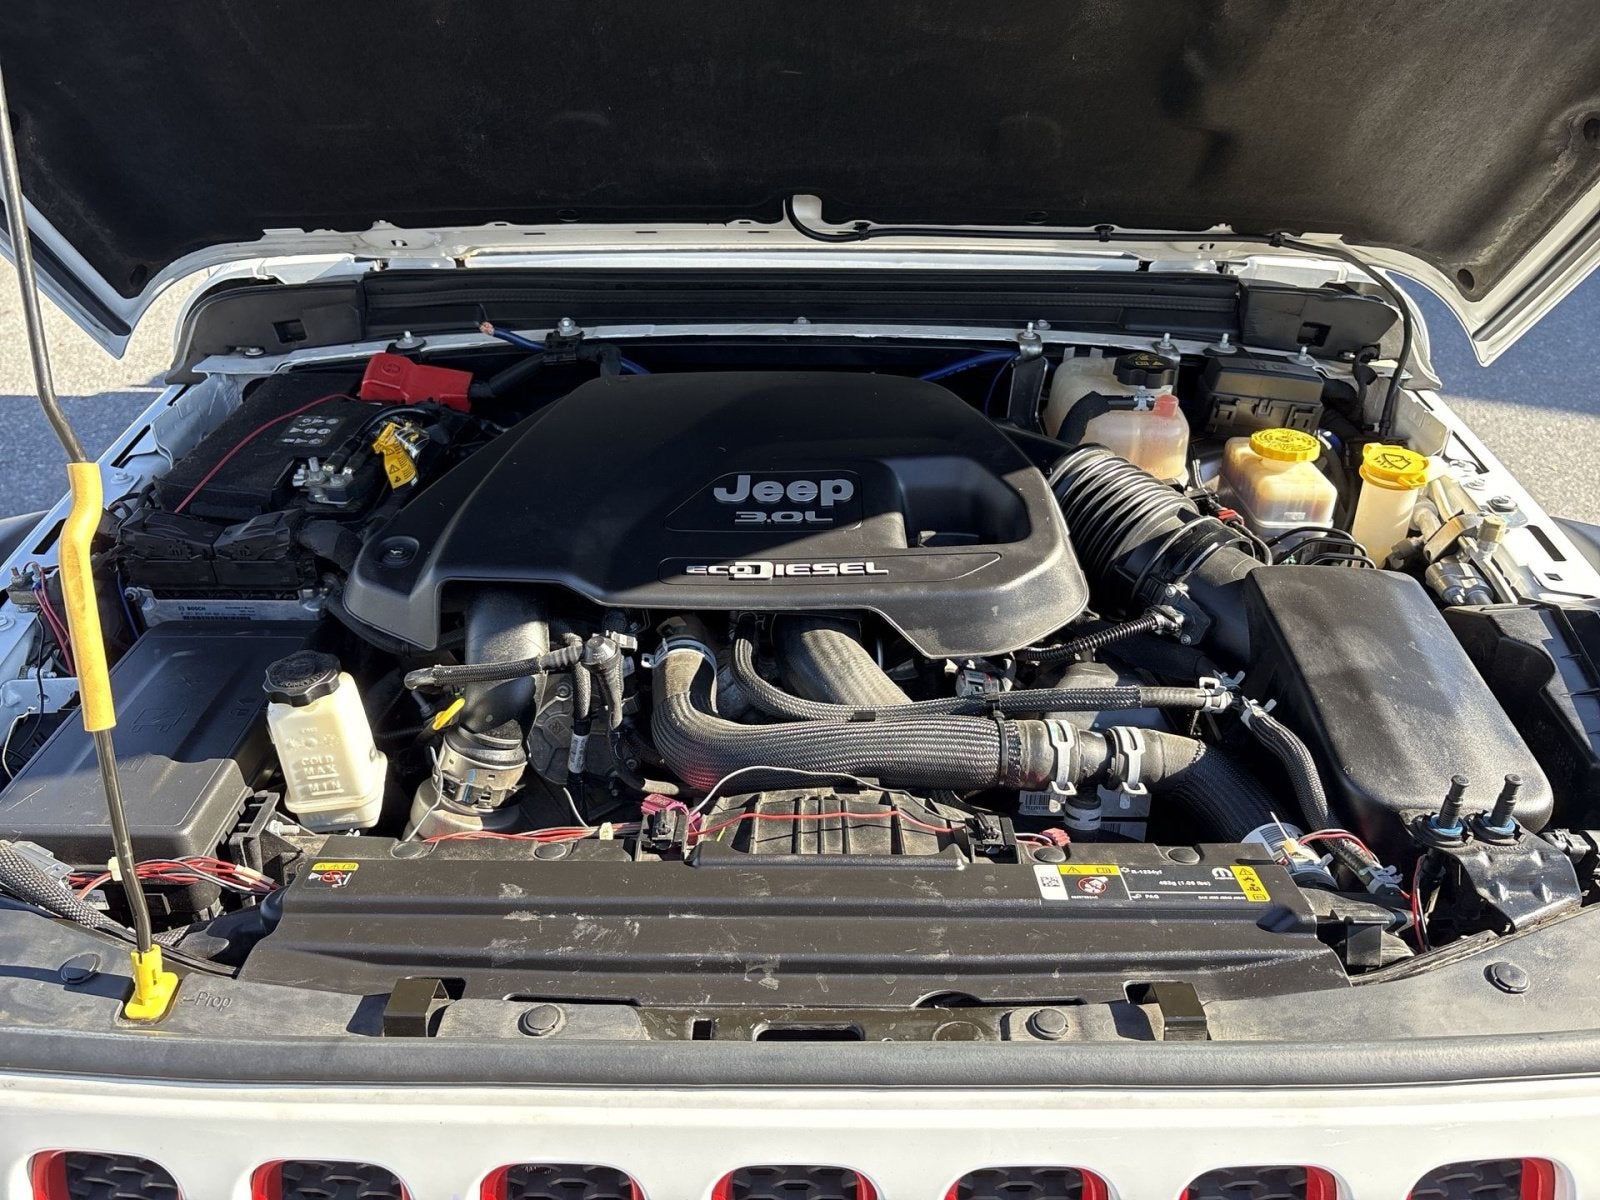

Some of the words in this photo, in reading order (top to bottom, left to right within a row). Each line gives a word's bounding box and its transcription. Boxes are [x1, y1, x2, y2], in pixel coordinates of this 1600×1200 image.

[713, 474, 854, 506] Jeep
[735, 511, 833, 524] 3.0L
[301, 754, 335, 766] COLD
[303, 763, 337, 776] MAX
[308, 778, 342, 792] MIN
[194, 991, 232, 1012] Prop
